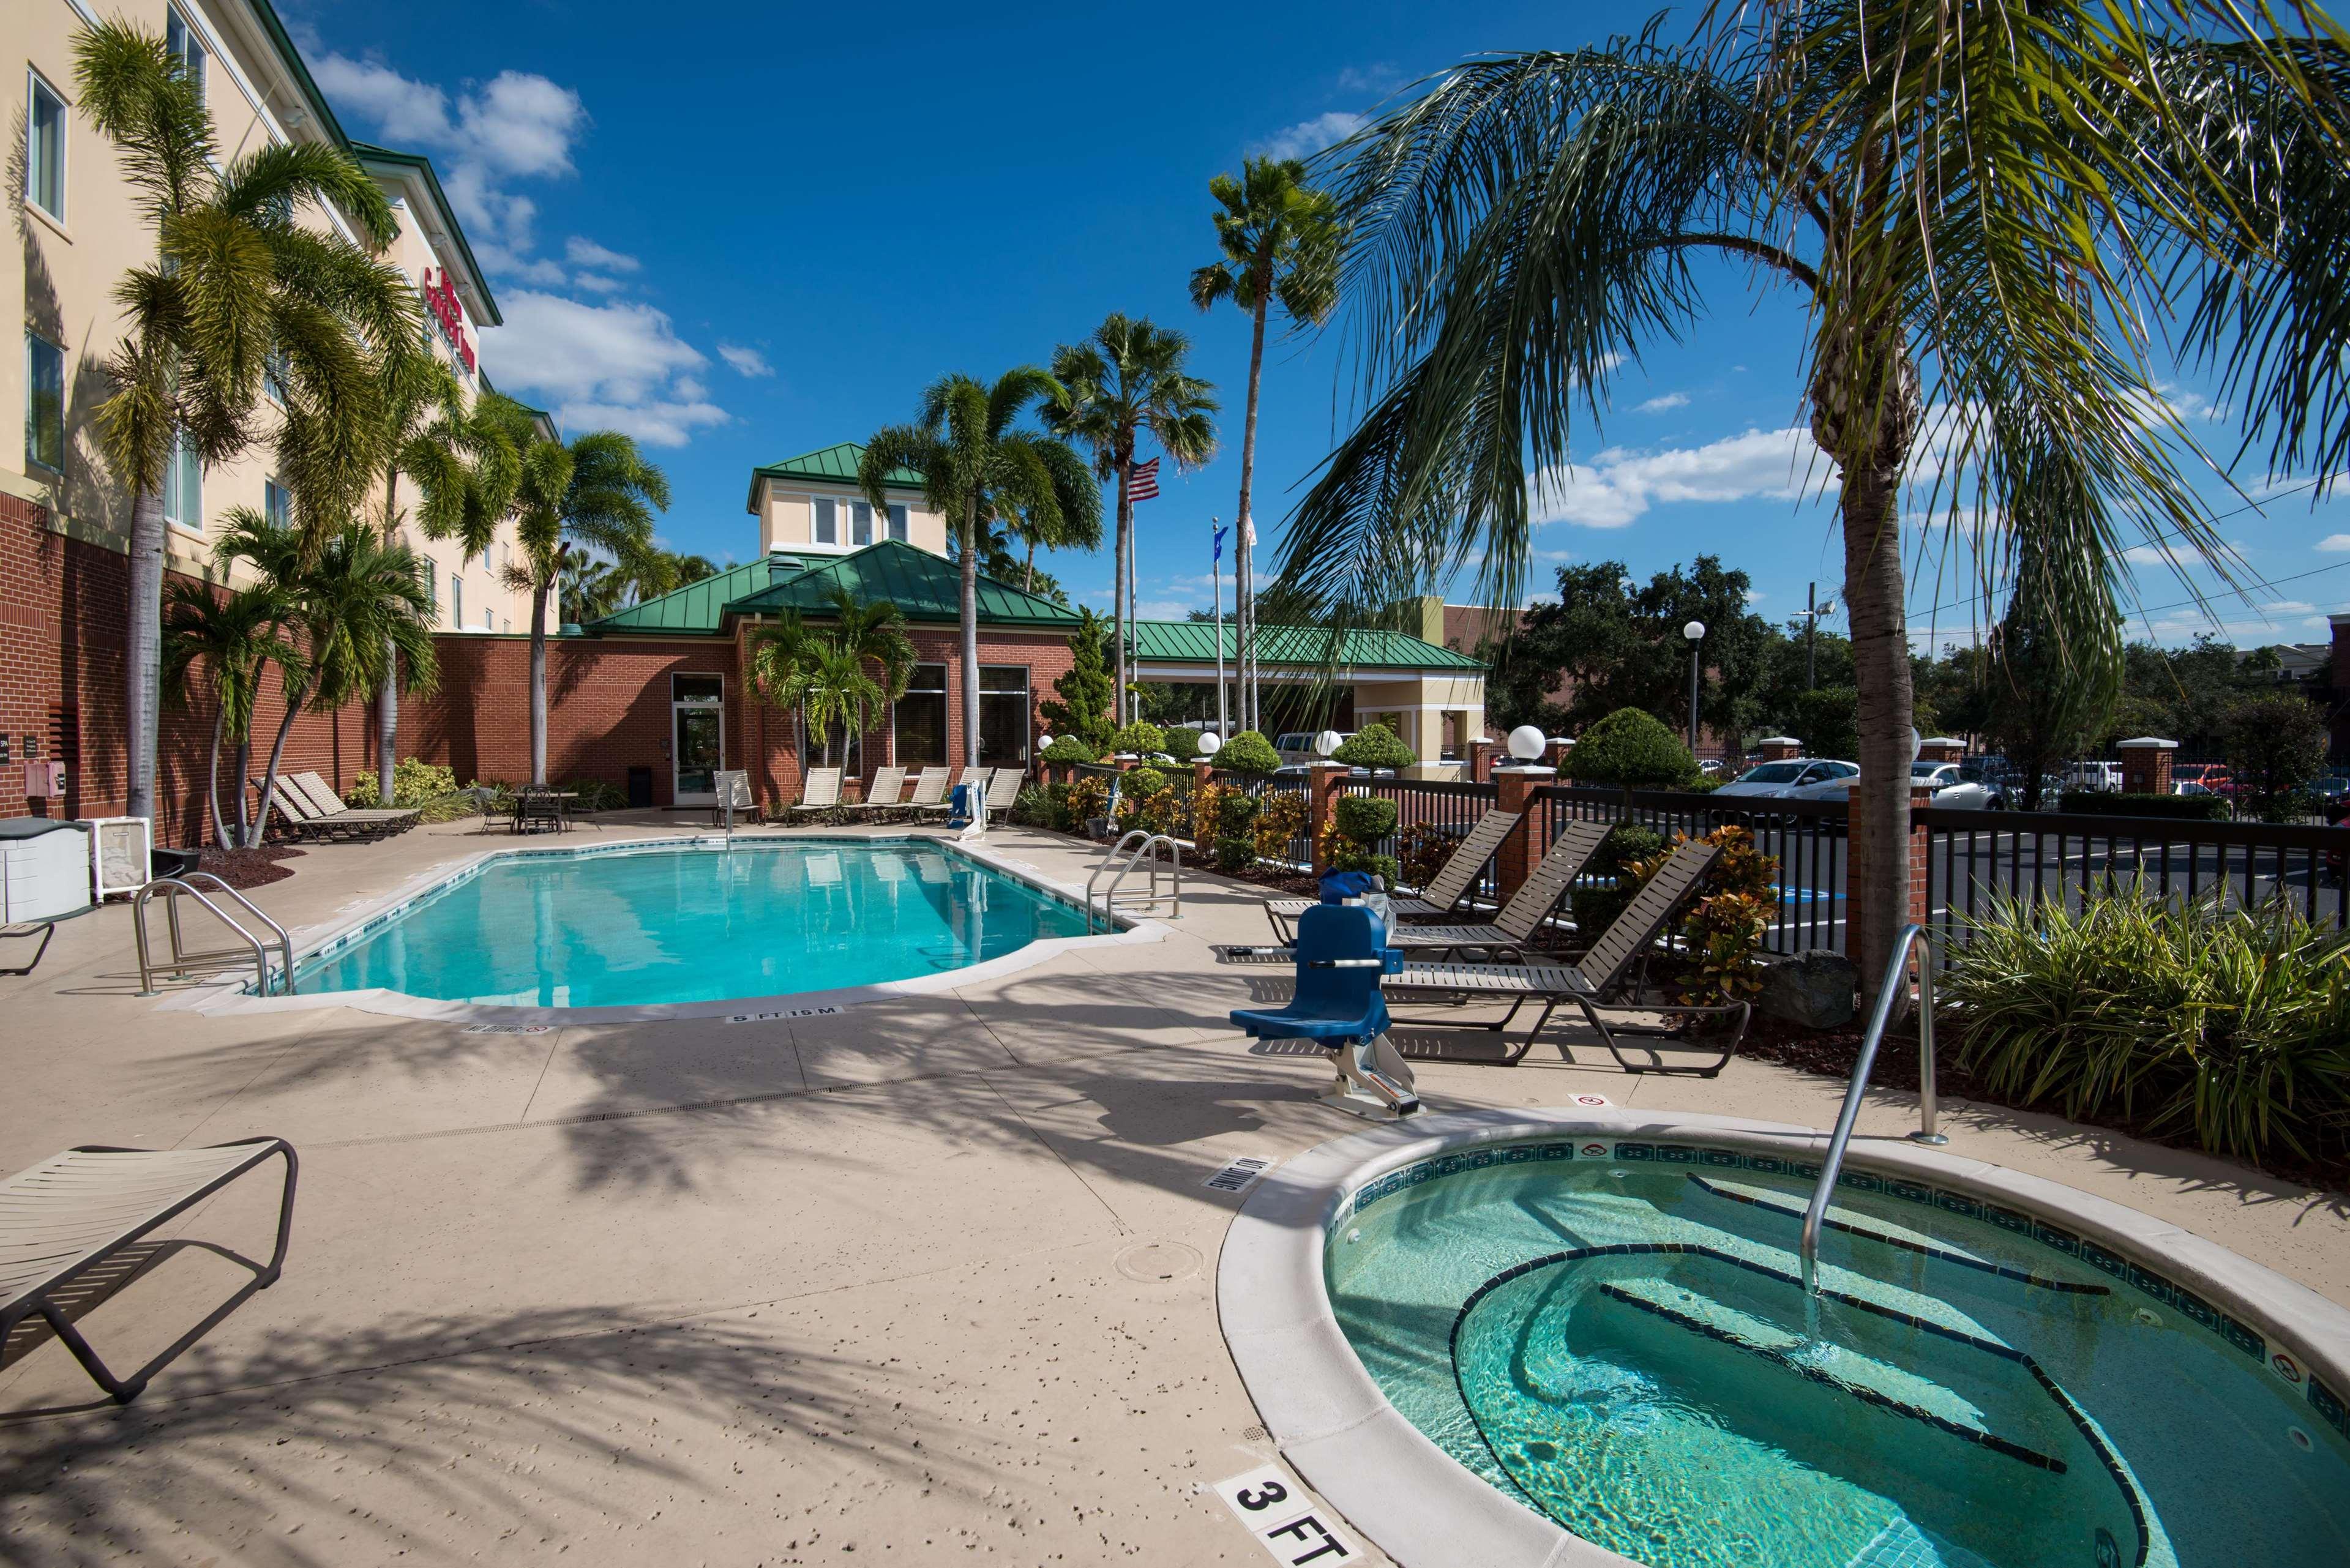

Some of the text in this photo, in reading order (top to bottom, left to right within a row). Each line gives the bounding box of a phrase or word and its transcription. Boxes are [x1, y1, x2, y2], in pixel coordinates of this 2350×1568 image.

[1208, 1157, 1268, 1190] NO DIVING
[1334, 1203, 1352, 1235] DIVING
[1237, 1481, 1350, 1567] 3 FT
